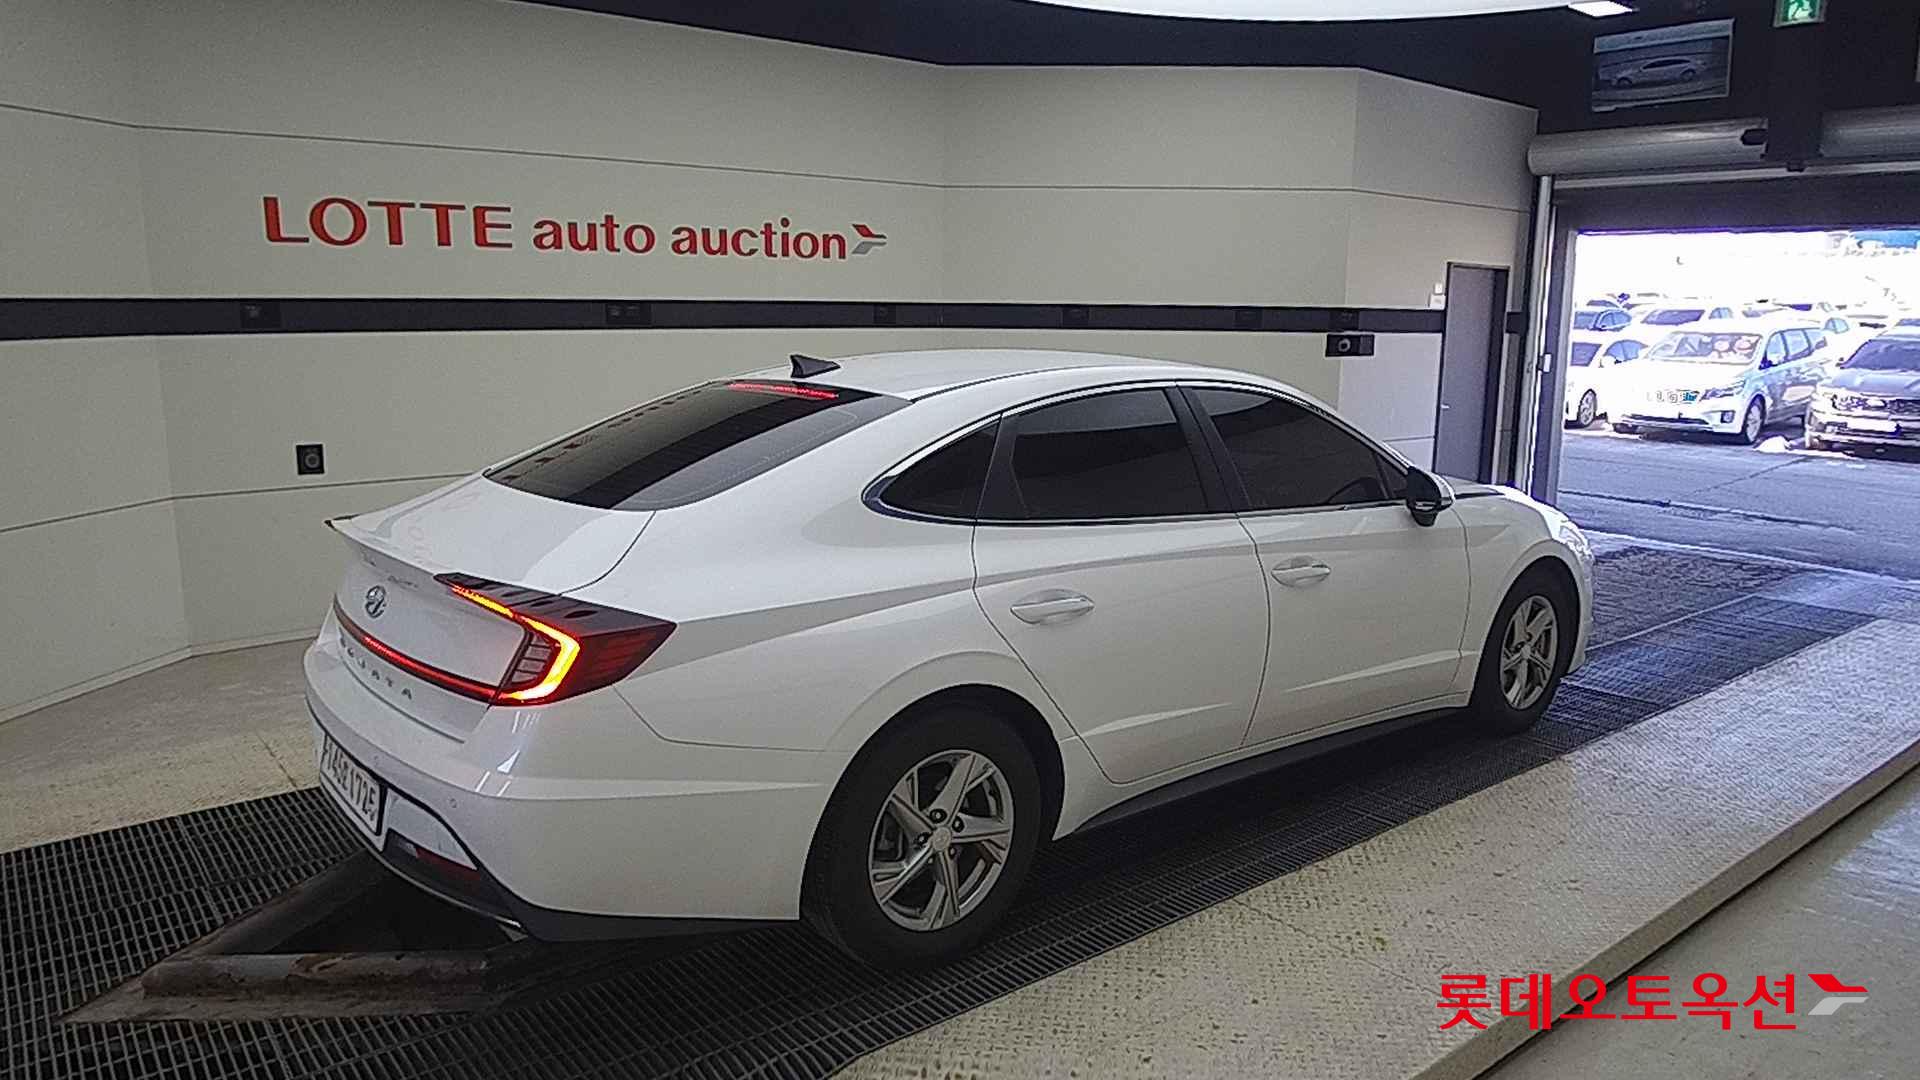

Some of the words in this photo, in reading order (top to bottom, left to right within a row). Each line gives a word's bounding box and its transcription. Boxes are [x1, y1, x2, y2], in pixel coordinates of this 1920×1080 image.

[263, 195, 513, 248] LOTTE
[533, 215, 656, 254] auto
[671, 217, 847, 259] auction
